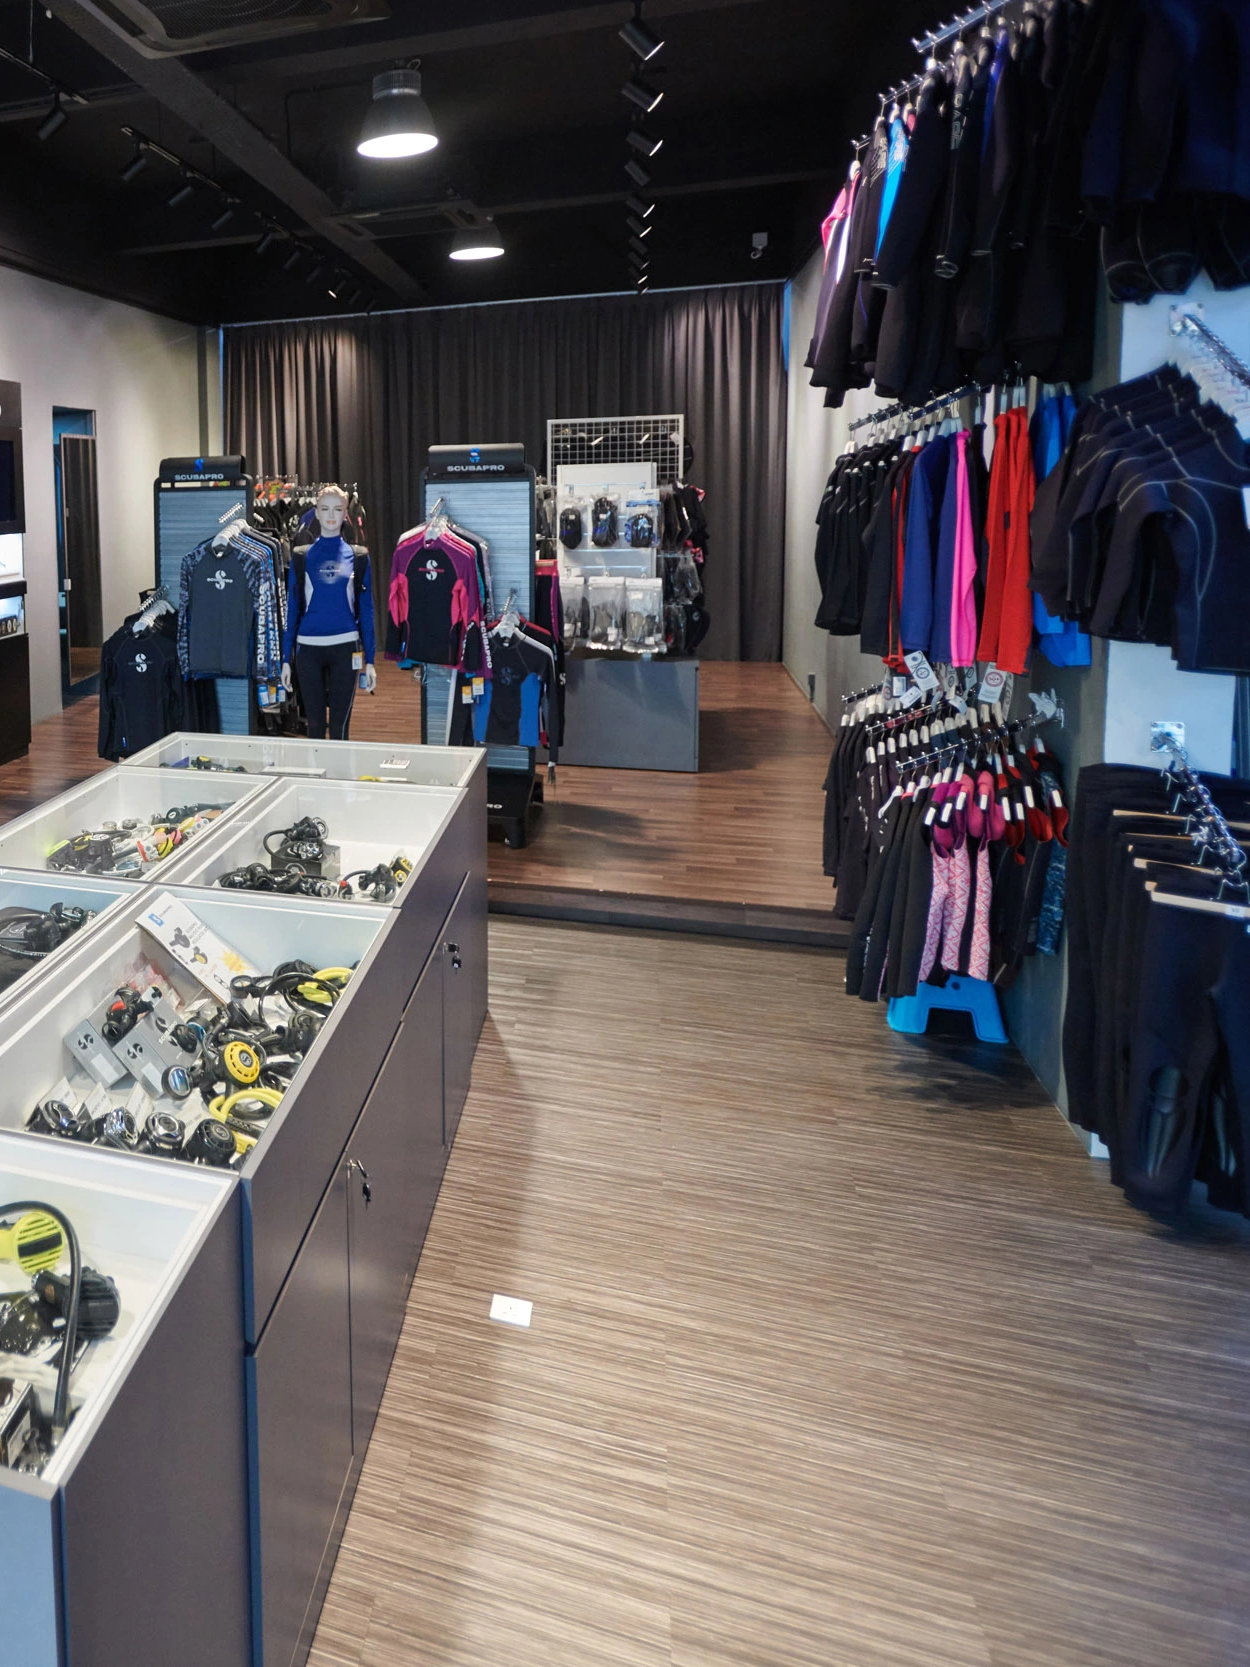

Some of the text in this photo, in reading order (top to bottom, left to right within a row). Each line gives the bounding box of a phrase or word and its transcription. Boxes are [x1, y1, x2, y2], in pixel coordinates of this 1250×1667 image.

[174, 472, 224, 481] SCUBAPRO
[446, 464, 506, 472] SCUBAPRO
[257, 584, 267, 664] SCUBAPRO
[478, 620, 493, 669] SCUBAPRO
